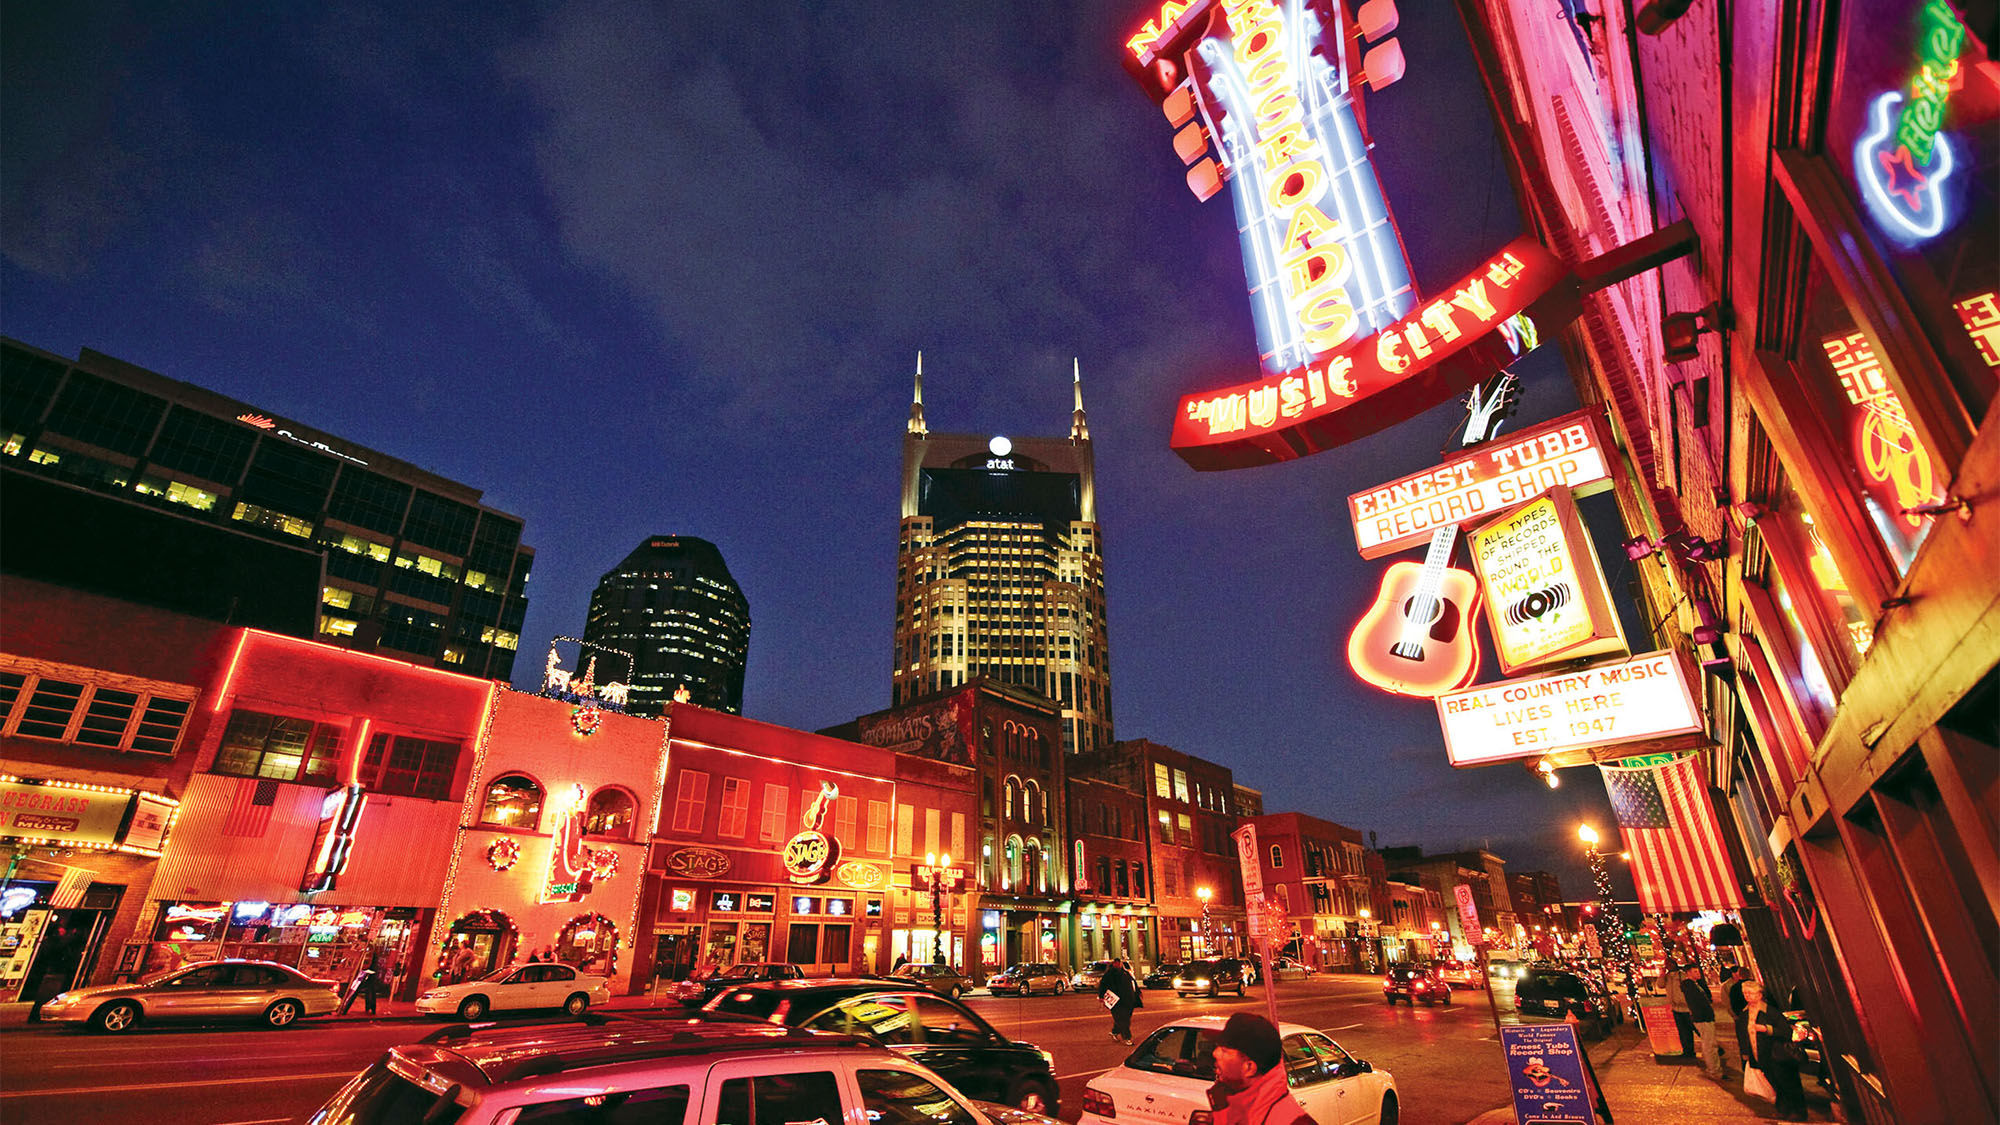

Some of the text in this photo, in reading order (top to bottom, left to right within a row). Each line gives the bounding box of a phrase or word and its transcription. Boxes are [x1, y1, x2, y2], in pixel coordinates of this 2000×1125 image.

[1126, 0, 1198, 59] NA
[1220, 0, 1359, 353] ROSSROADS
[1209, 278, 1498, 436] MUSIC CITY
[986, 458, 1014, 470] at&t
[1354, 424, 1590, 520] ERNEST TUBB
[1376, 459, 1578, 541] RECORD SHOP
[1481, 514, 1557, 561] OF RECORDS
[1484, 506, 1547, 547] ALL TYPES
[1491, 541, 1561, 582] ROUND THE
[1497, 534, 1547, 567] SHIPPED
[1496, 556, 1563, 597] WORLD
[1447, 661, 1668, 714] REAL COUNTRY MUSIC
[1493, 692, 1624, 727] LIVES HERE
[1512, 717, 1617, 746] EST. 1947
[17, 821, 75, 832] MUSIC
[671, 850, 728, 870] STAGE
[786, 840, 826, 867] STAGE
[841, 865, 880, 882] STAGE
[309, 933, 333, 942] ATM
[1548, 1048, 1573, 1056] Shop
[1126, 1104, 1175, 1117] MAXIMA
